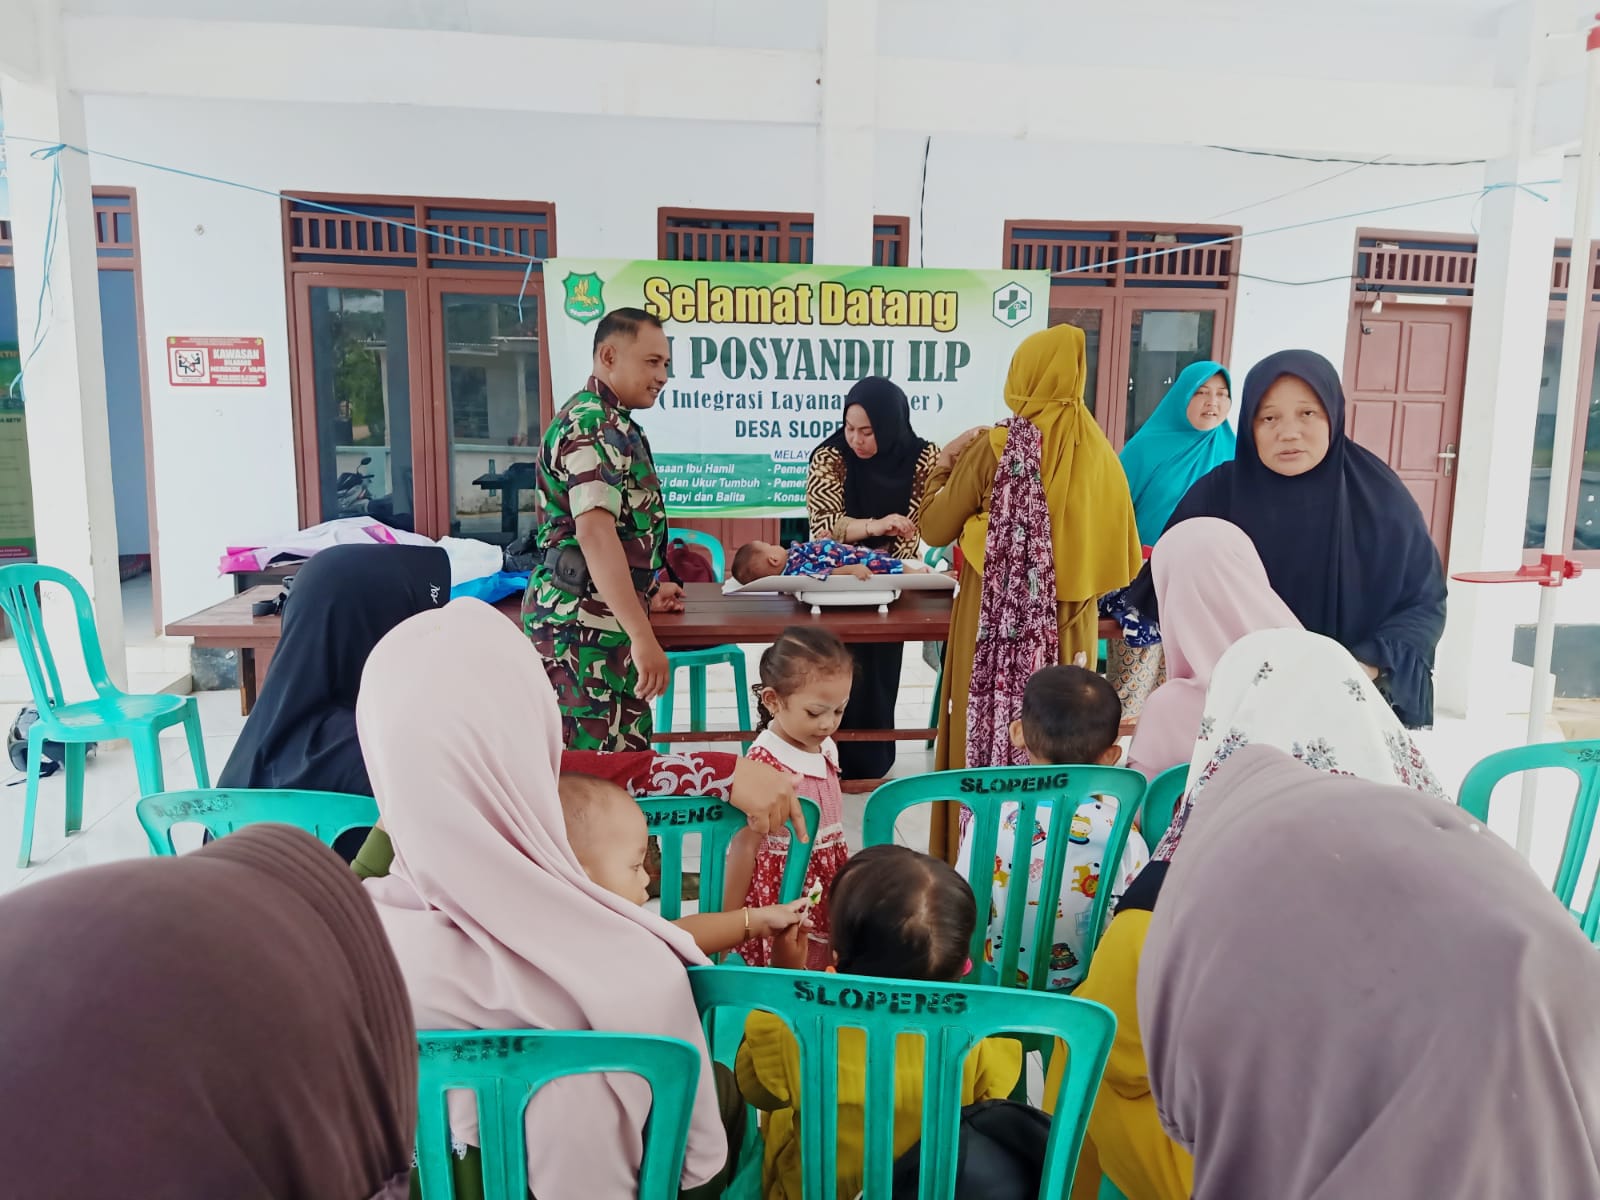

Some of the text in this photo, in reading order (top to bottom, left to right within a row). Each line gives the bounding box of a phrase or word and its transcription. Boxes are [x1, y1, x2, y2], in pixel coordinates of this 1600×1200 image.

[644, 276, 958, 332] Selamat Datang
[690, 336, 894, 381] POSYANDU
[907, 340, 971, 382] ILP
[672, 389, 763, 411] Integrasi
[735, 420, 782, 438] DESA
[774, 450, 810, 460] MELAY
[686, 463, 702, 473] Ibu
[704, 463, 735, 473] Hamil
[773, 463, 809, 474] Pemeri
[669, 477, 689, 488] dan
[692, 477, 717, 488] Ukur
[719, 478, 760, 488] Tumbuh
[773, 478, 807, 488] Pemer
[669, 491, 692, 504] Bayi
[694, 491, 713, 502] dan
[716, 492, 745, 502] Balita
[773, 492, 807, 502] Konsu
[960, 773, 1069, 794] SLOPENG
[792, 979, 968, 1015] SLOPENG
